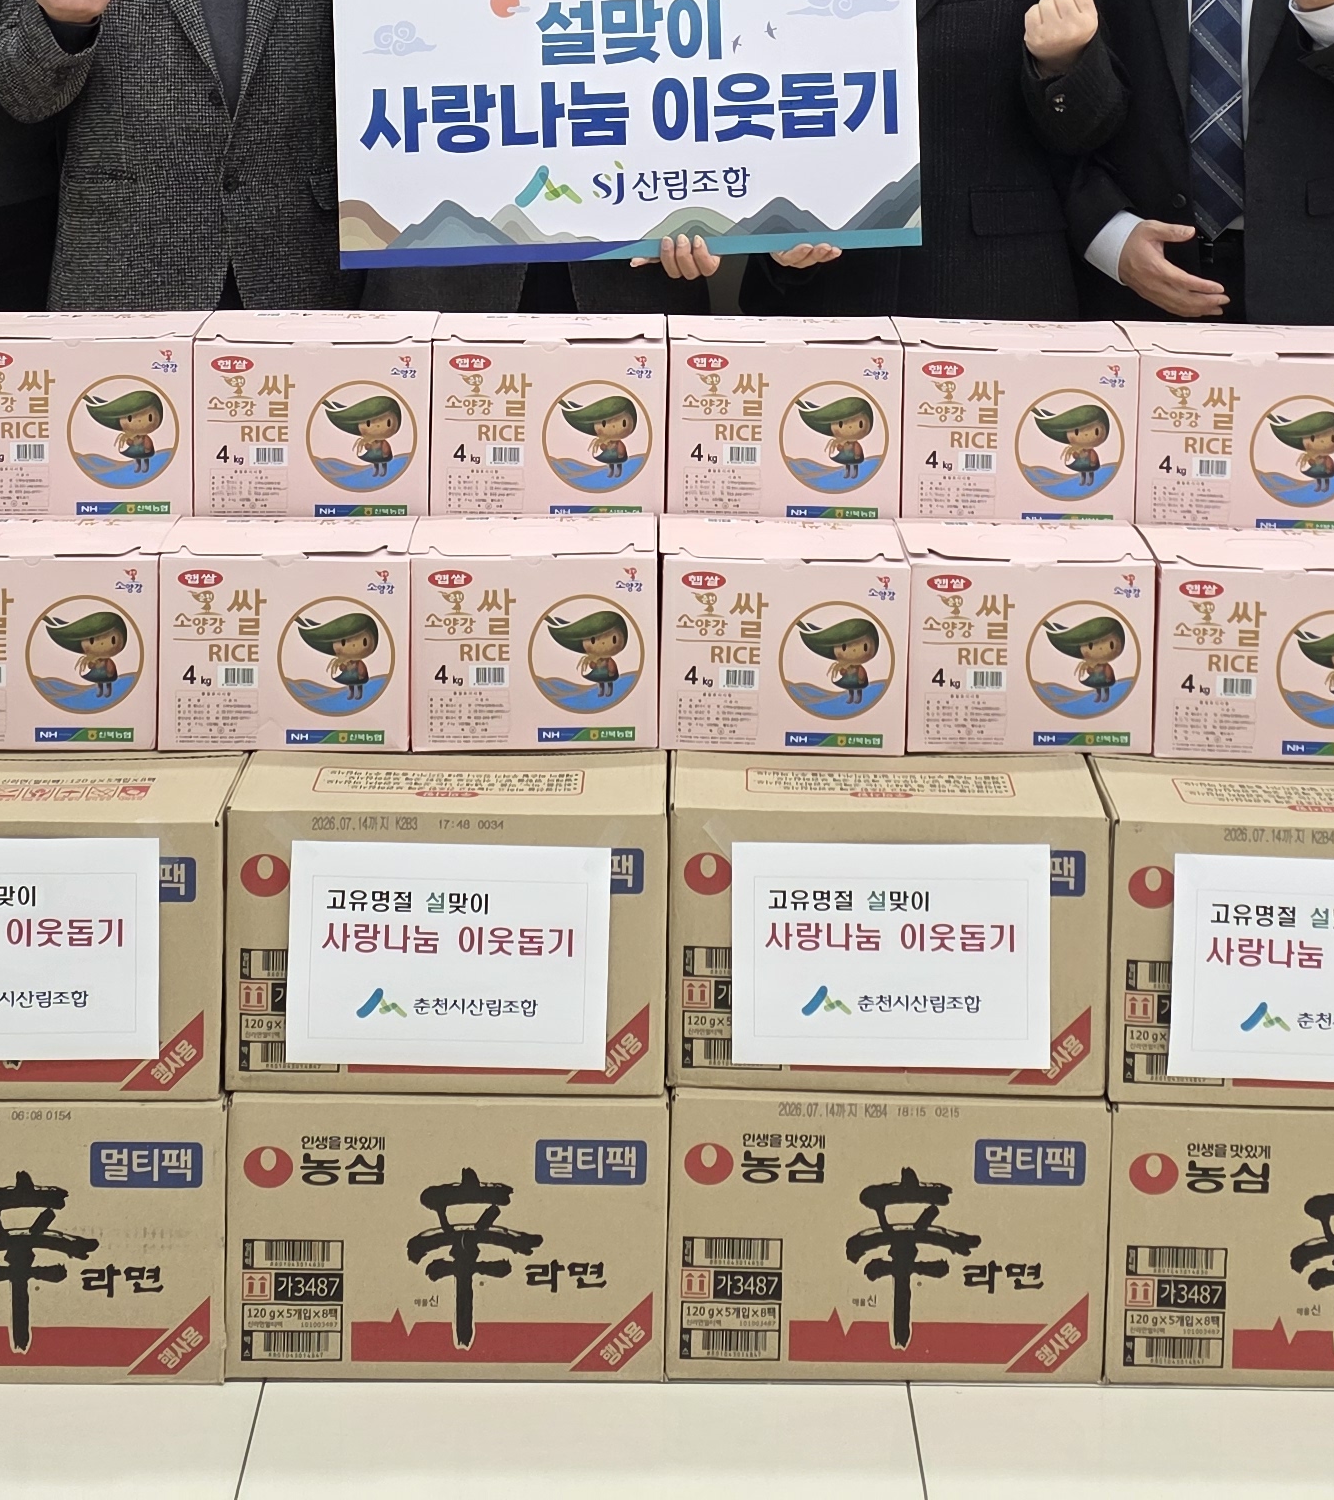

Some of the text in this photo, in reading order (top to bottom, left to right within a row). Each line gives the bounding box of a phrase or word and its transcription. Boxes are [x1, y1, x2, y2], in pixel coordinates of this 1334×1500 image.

[359, 69, 899, 154] 사랑나눔 이웃돕기
[632, 165, 751, 201] 산림조합
[710, 646, 761, 664] RICE
[326, 889, 490, 915] 고유명절 설맞이
[768, 889, 930, 912] 고유명절 설맞이
[1210, 903, 1296, 928] 고유명절
[6, 918, 124, 948] 이웃돕기
[321, 922, 574, 958] 사랑나눔 이웃돕기
[765, 922, 1016, 953] 사랑나눔 이웃돕기
[1205, 936, 1324, 969] 사랑나눔
[412, 997, 538, 1018] 춘천시산림조합
[857, 994, 981, 1014] 춘천시산림조합
[100, 1149, 193, 1182] 멀티팩
[299, 1153, 385, 1185] 농심
[545, 1146, 637, 1179] 멀티팩
[740, 1150, 825, 1183] 농심
[984, 1146, 1076, 1180] 멀티팩
[1185, 1160, 1271, 1193] 농심
[716, 1274, 779, 1297] 가3487
